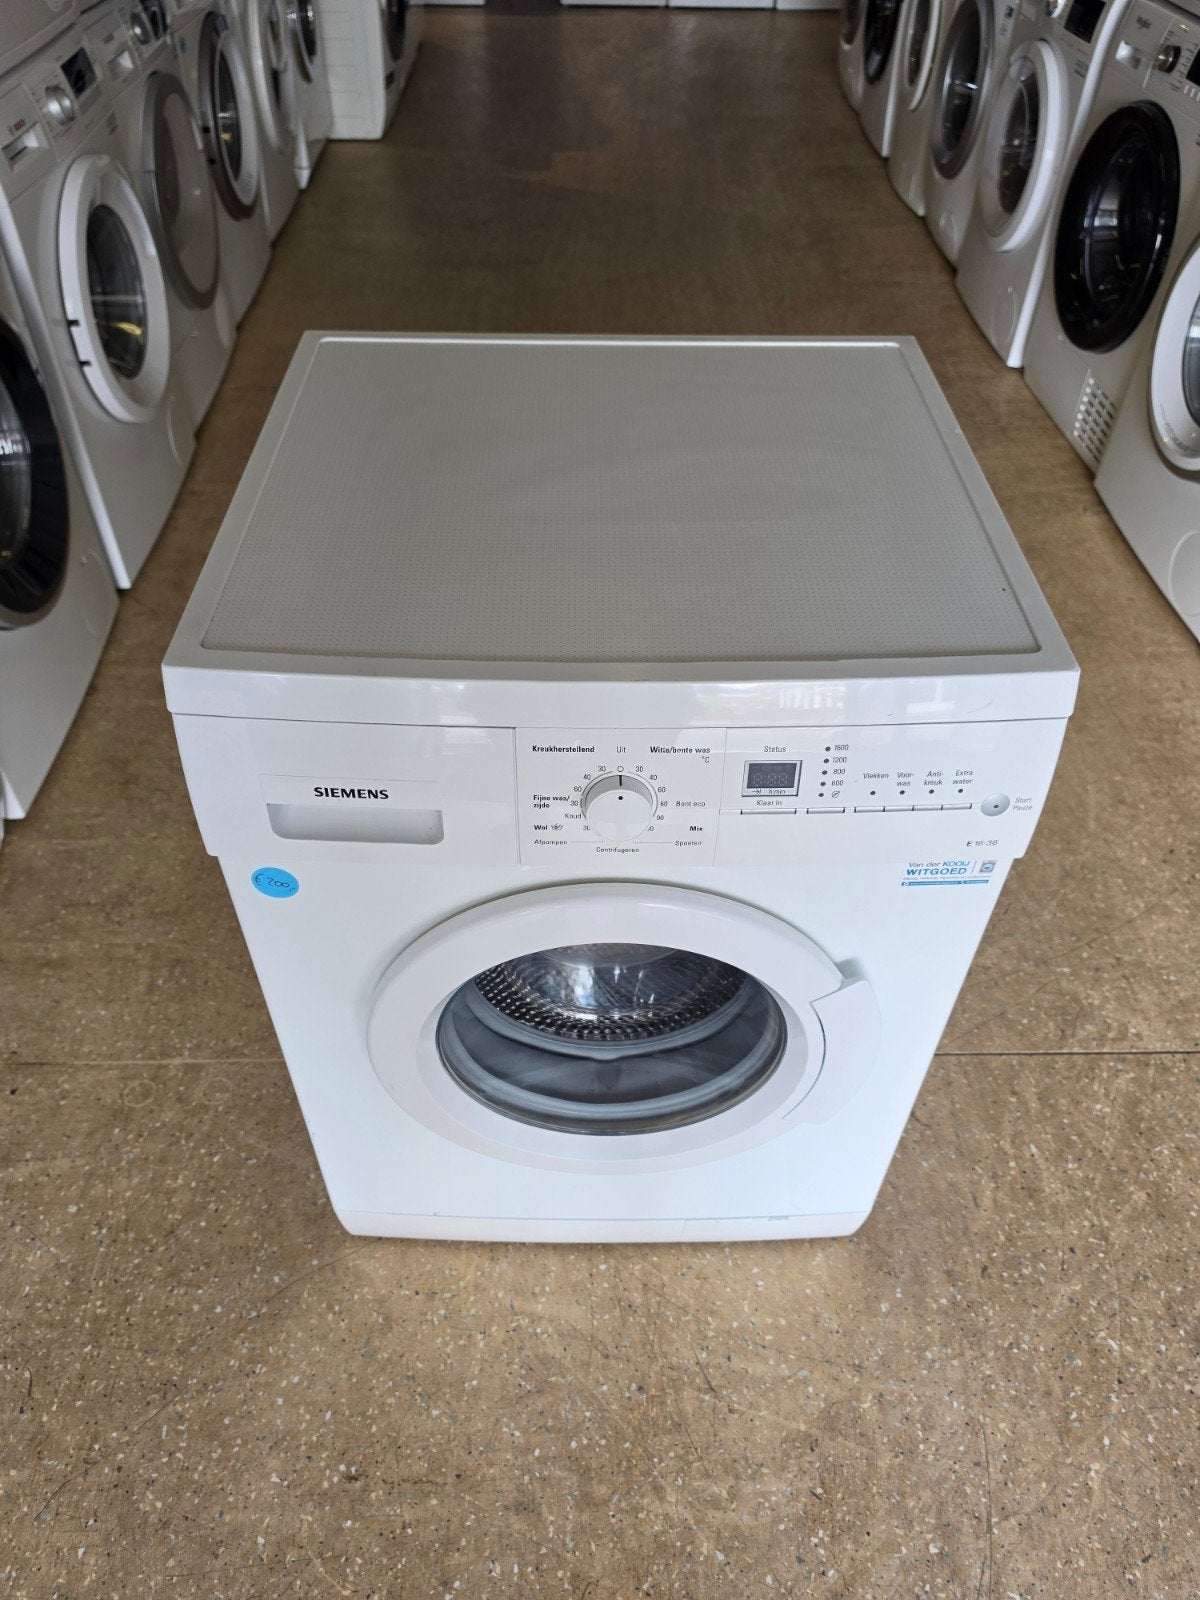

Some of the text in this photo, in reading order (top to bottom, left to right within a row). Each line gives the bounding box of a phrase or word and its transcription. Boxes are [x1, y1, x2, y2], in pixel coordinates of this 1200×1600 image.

[532, 745, 595, 753] Kreukherstellend
[583, 773, 592, 781] 40
[897, 771, 915, 779] Voor-
[313, 787, 389, 799] SIEMENS
[533, 838, 568, 846] Afpompen
[595, 846, 640, 854] Centrifugeren
[906, 867, 967, 876] WITGOED
